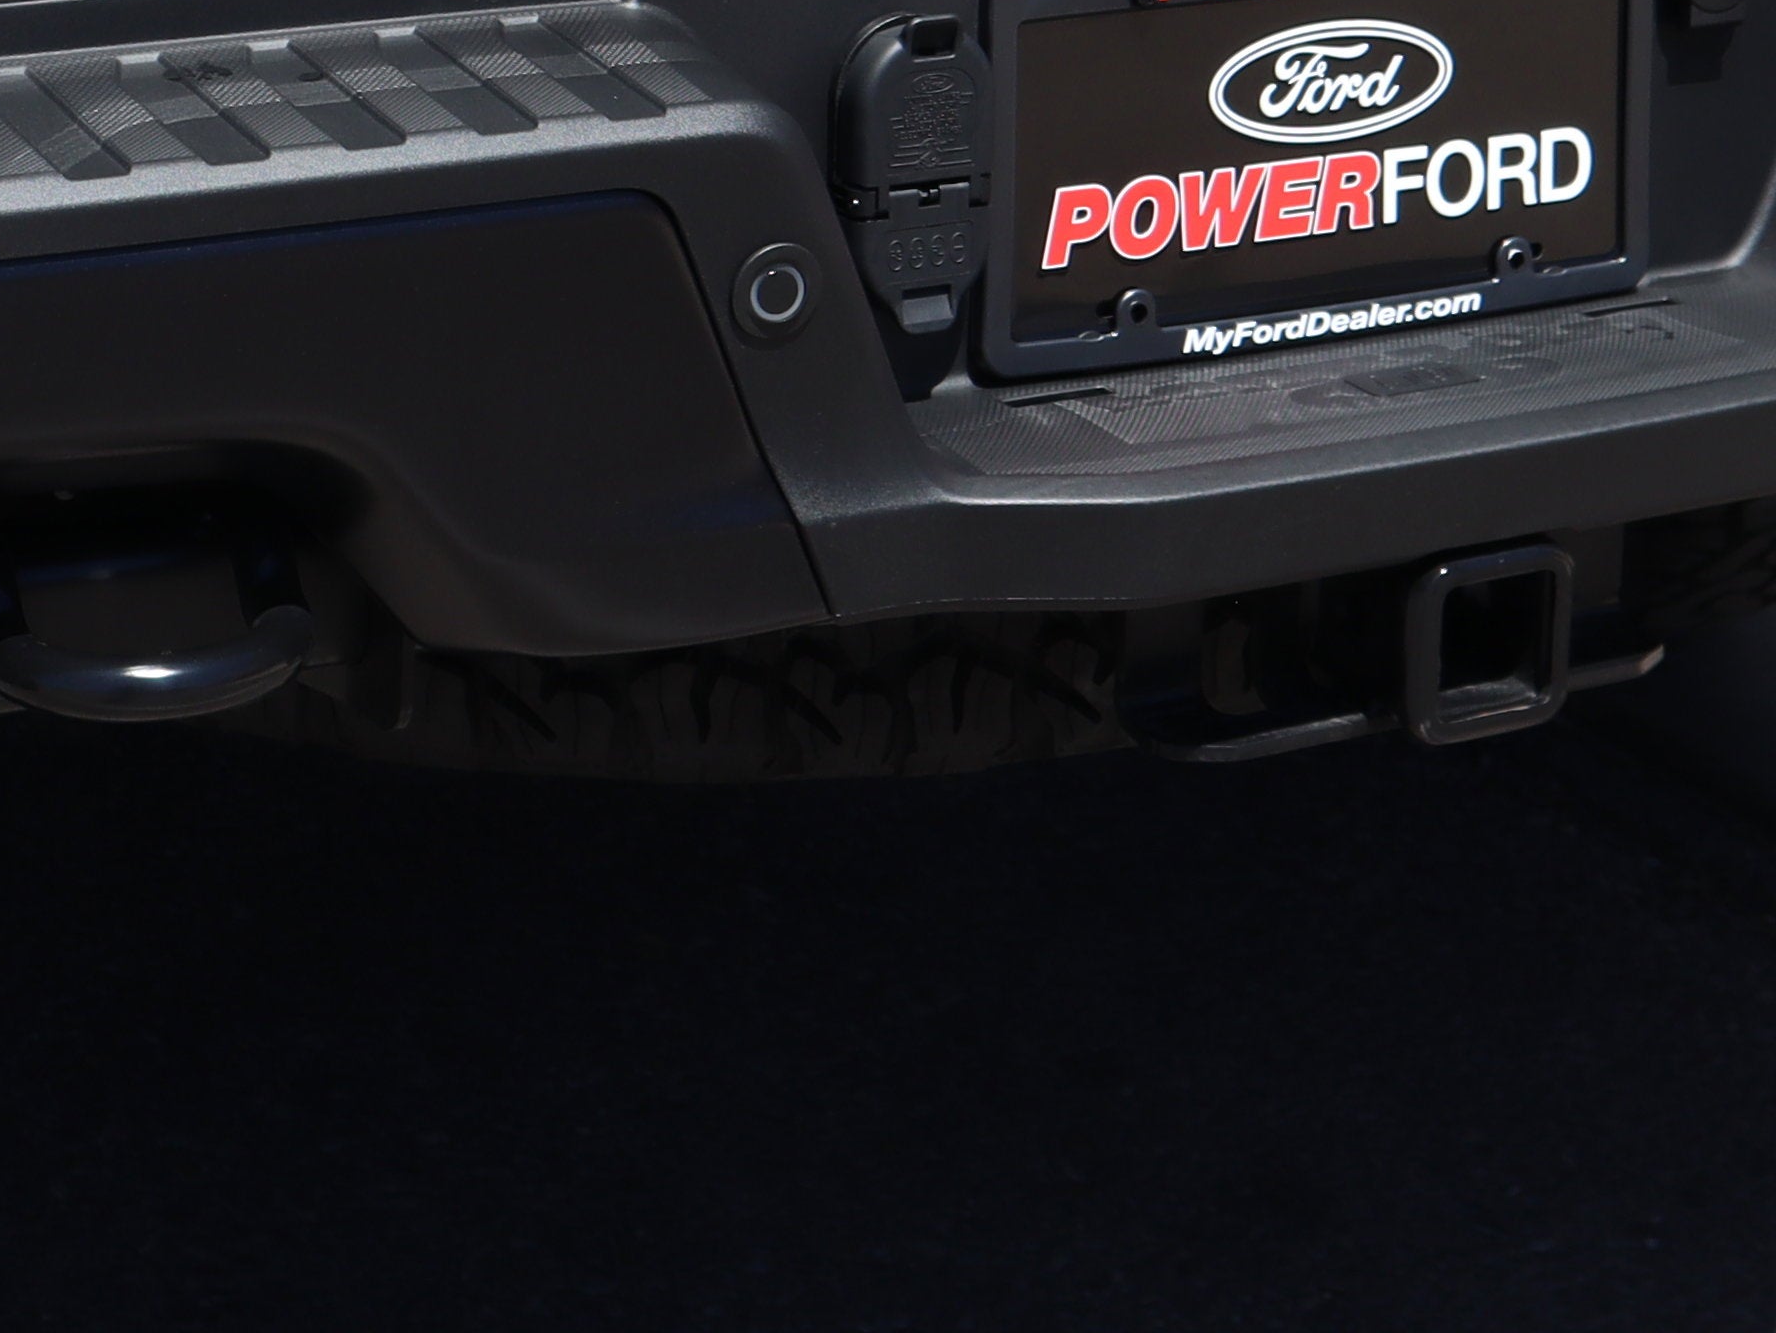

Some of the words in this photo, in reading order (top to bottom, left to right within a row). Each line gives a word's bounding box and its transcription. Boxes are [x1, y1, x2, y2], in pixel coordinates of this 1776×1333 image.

[1258, 42, 1404, 119] Ford
[1039, 126, 1595, 271] POWERFORD
[1182, 289, 1482, 358] MyFordDealer.com
